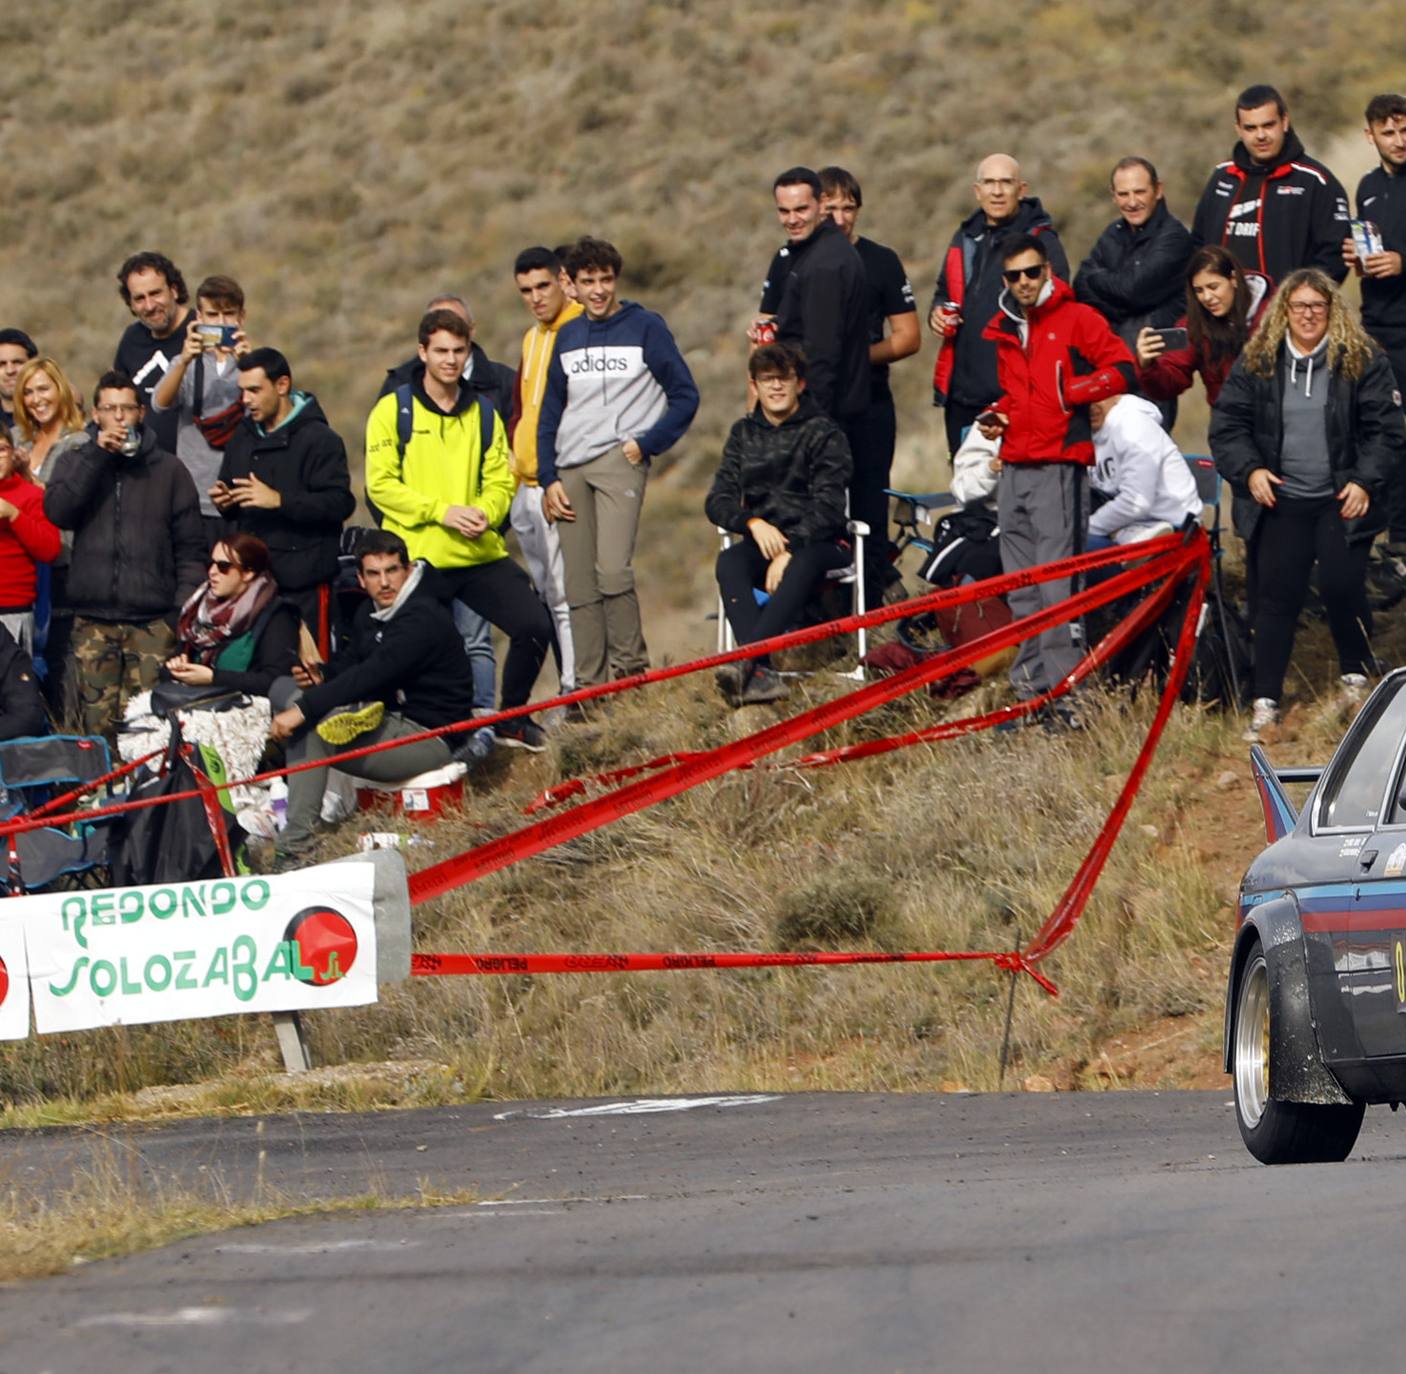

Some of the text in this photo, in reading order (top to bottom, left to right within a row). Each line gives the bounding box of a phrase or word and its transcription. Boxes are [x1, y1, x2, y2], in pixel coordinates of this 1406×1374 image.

[1236, 222, 1261, 236] DRIF
[571, 354, 629, 374] adidas
[62, 879, 271, 949] REDONDO
[49, 934, 314, 1002] SOLOZABAL
[474, 956, 529, 971] PELIGRO
